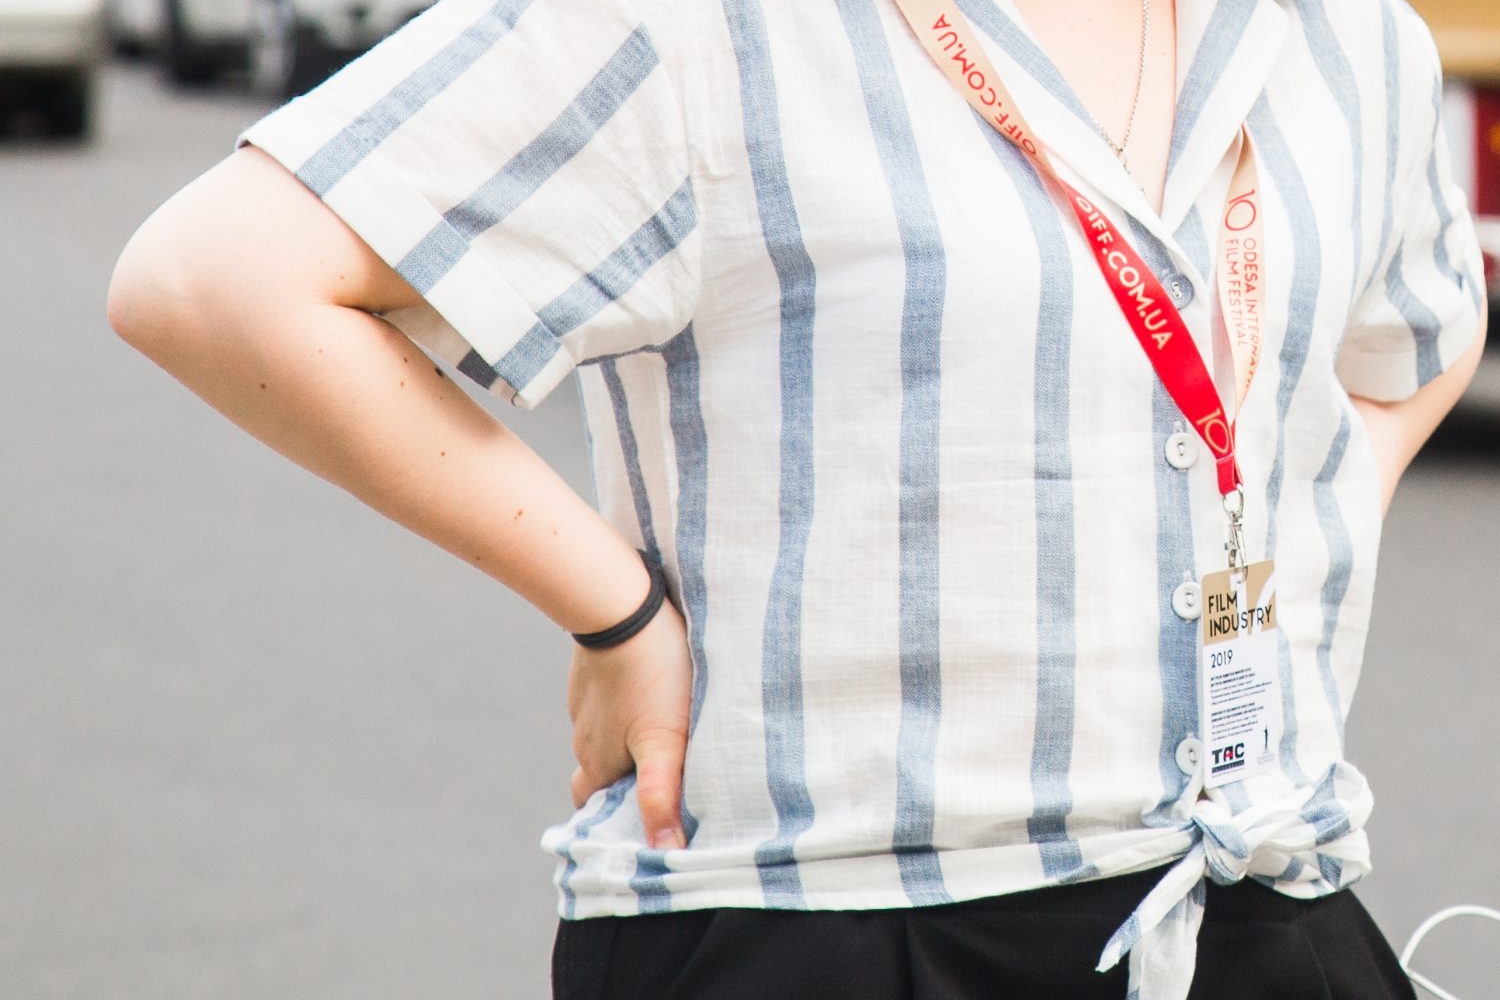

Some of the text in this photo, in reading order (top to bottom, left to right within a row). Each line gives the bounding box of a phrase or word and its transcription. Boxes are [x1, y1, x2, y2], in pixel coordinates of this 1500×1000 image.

[932, 13, 1037, 157] OIFF.COM.UA
[1075, 195, 1173, 350] OIFF.COM.UA
[1226, 239, 1249, 347] FILM FESTIVAL
[1243, 238, 1258, 293] ODESA
[1208, 590, 1238, 615] FILM
[1209, 604, 1272, 638] INDUSTRY
[1210, 650, 1233, 669] 2019
